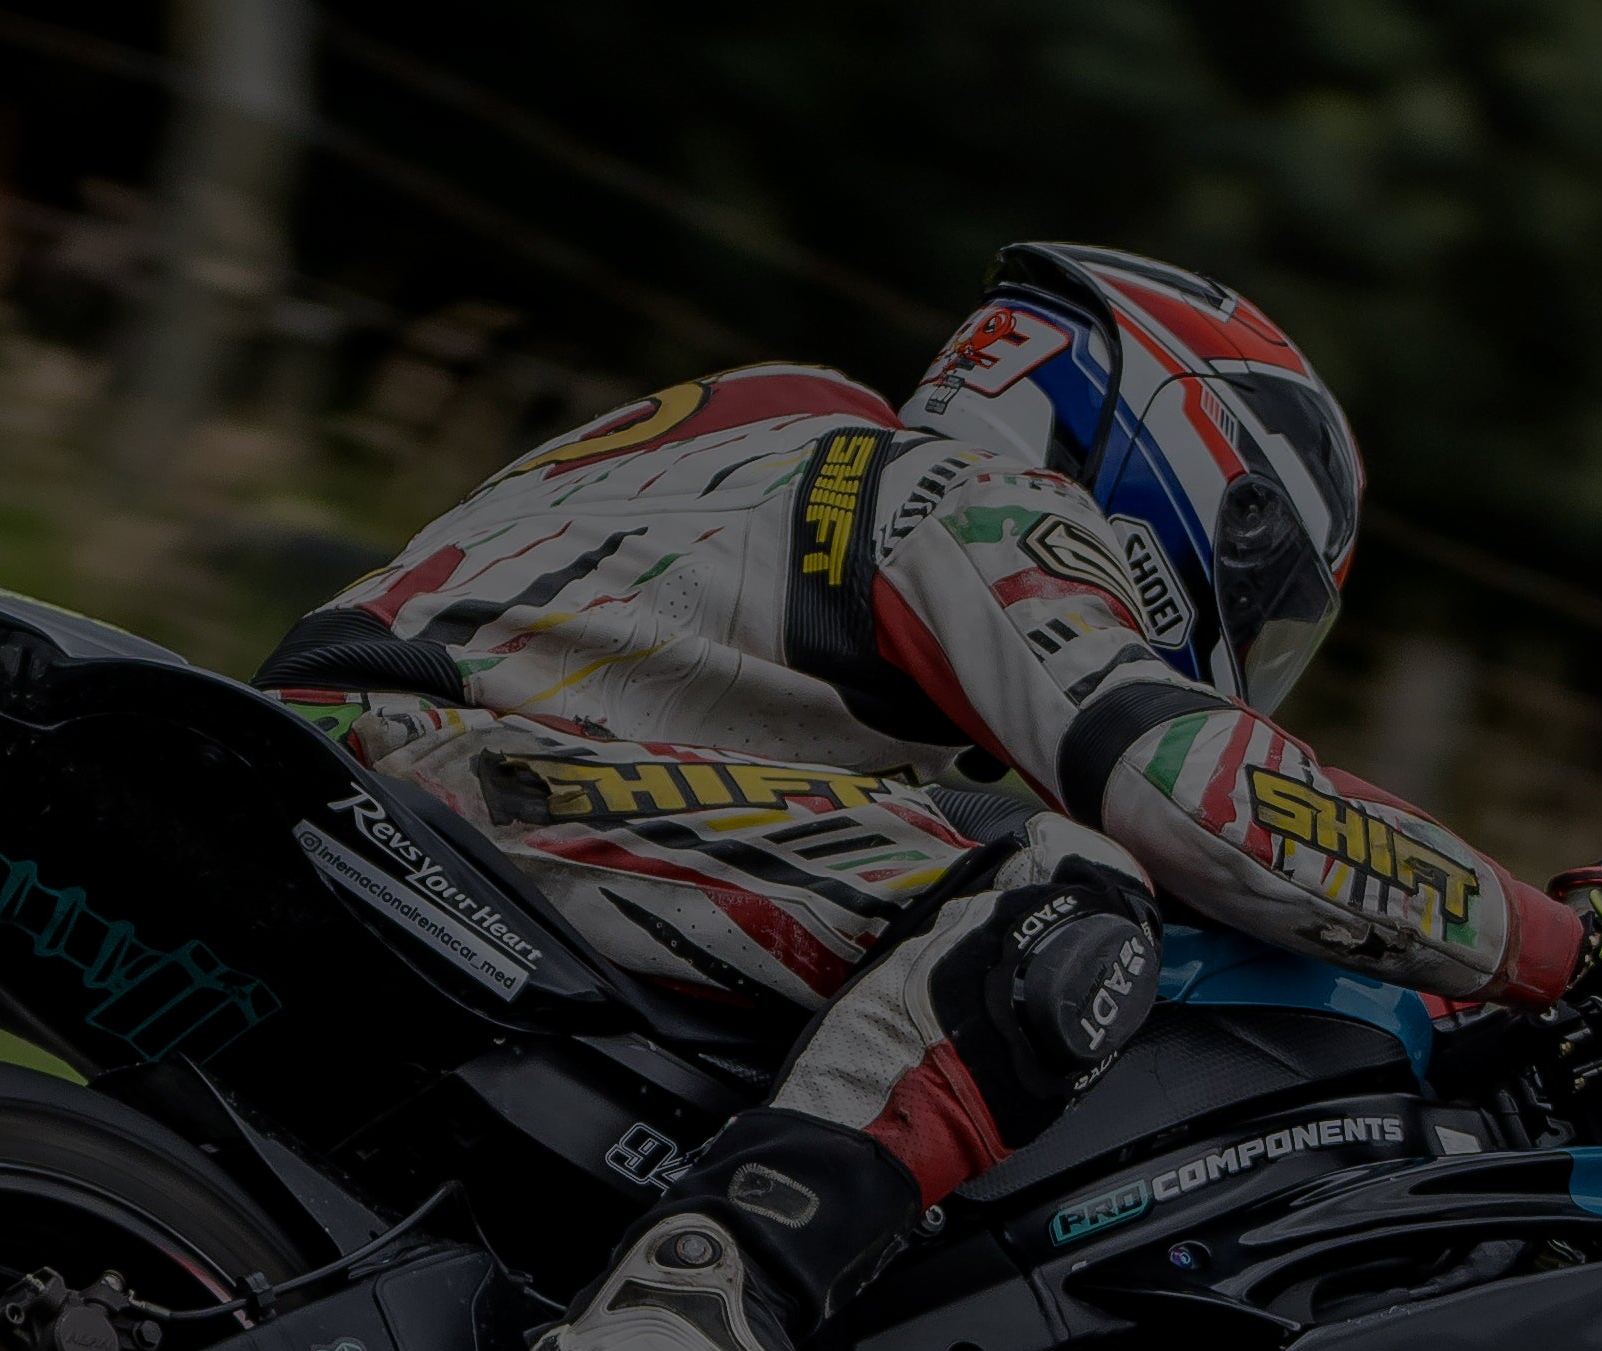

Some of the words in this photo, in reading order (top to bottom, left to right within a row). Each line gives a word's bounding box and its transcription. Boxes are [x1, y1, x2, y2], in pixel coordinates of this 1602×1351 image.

[802, 434, 878, 588] SHIFT
[1124, 533, 1183, 636] SHOEI
[1249, 766, 1480, 923] SHIFT
[1056, 1182, 1145, 1238] PRO
[1152, 1116, 1403, 1201] COMPONENTS
